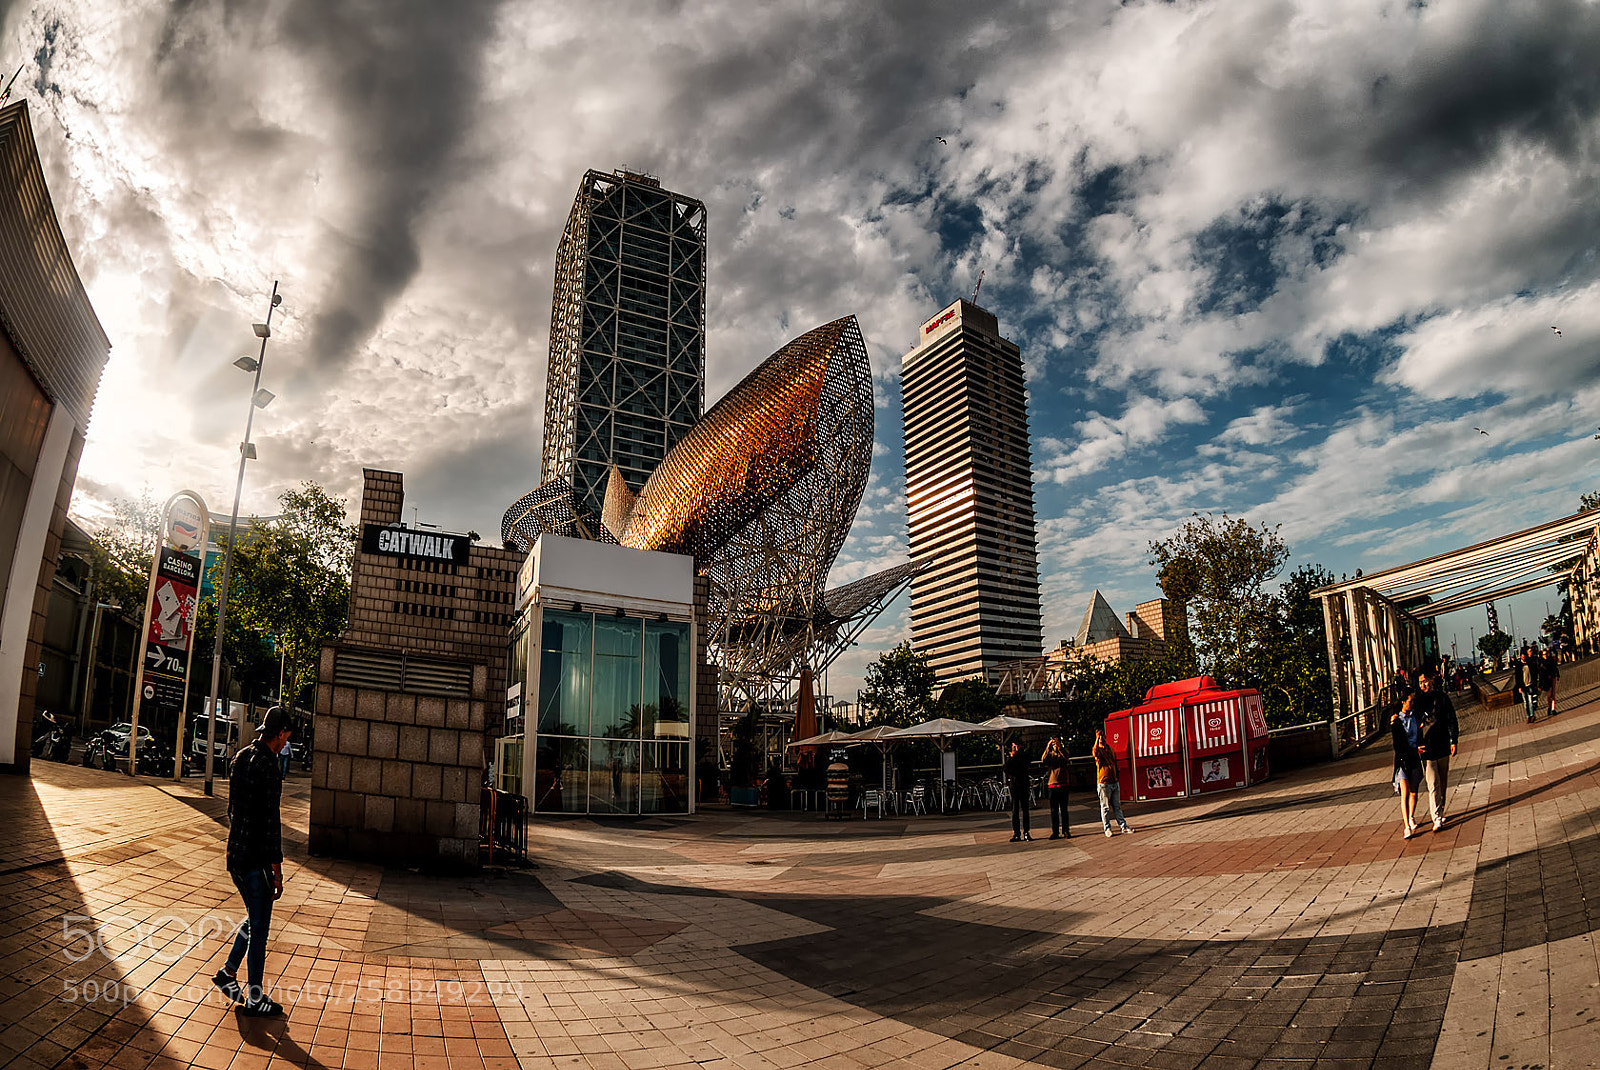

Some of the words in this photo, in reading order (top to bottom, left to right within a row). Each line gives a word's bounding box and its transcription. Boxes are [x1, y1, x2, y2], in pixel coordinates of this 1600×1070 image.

[379, 530, 454, 559] CATWALK
[163, 562, 195, 578] BARCELONA
[167, 556, 193, 571] CASINO
